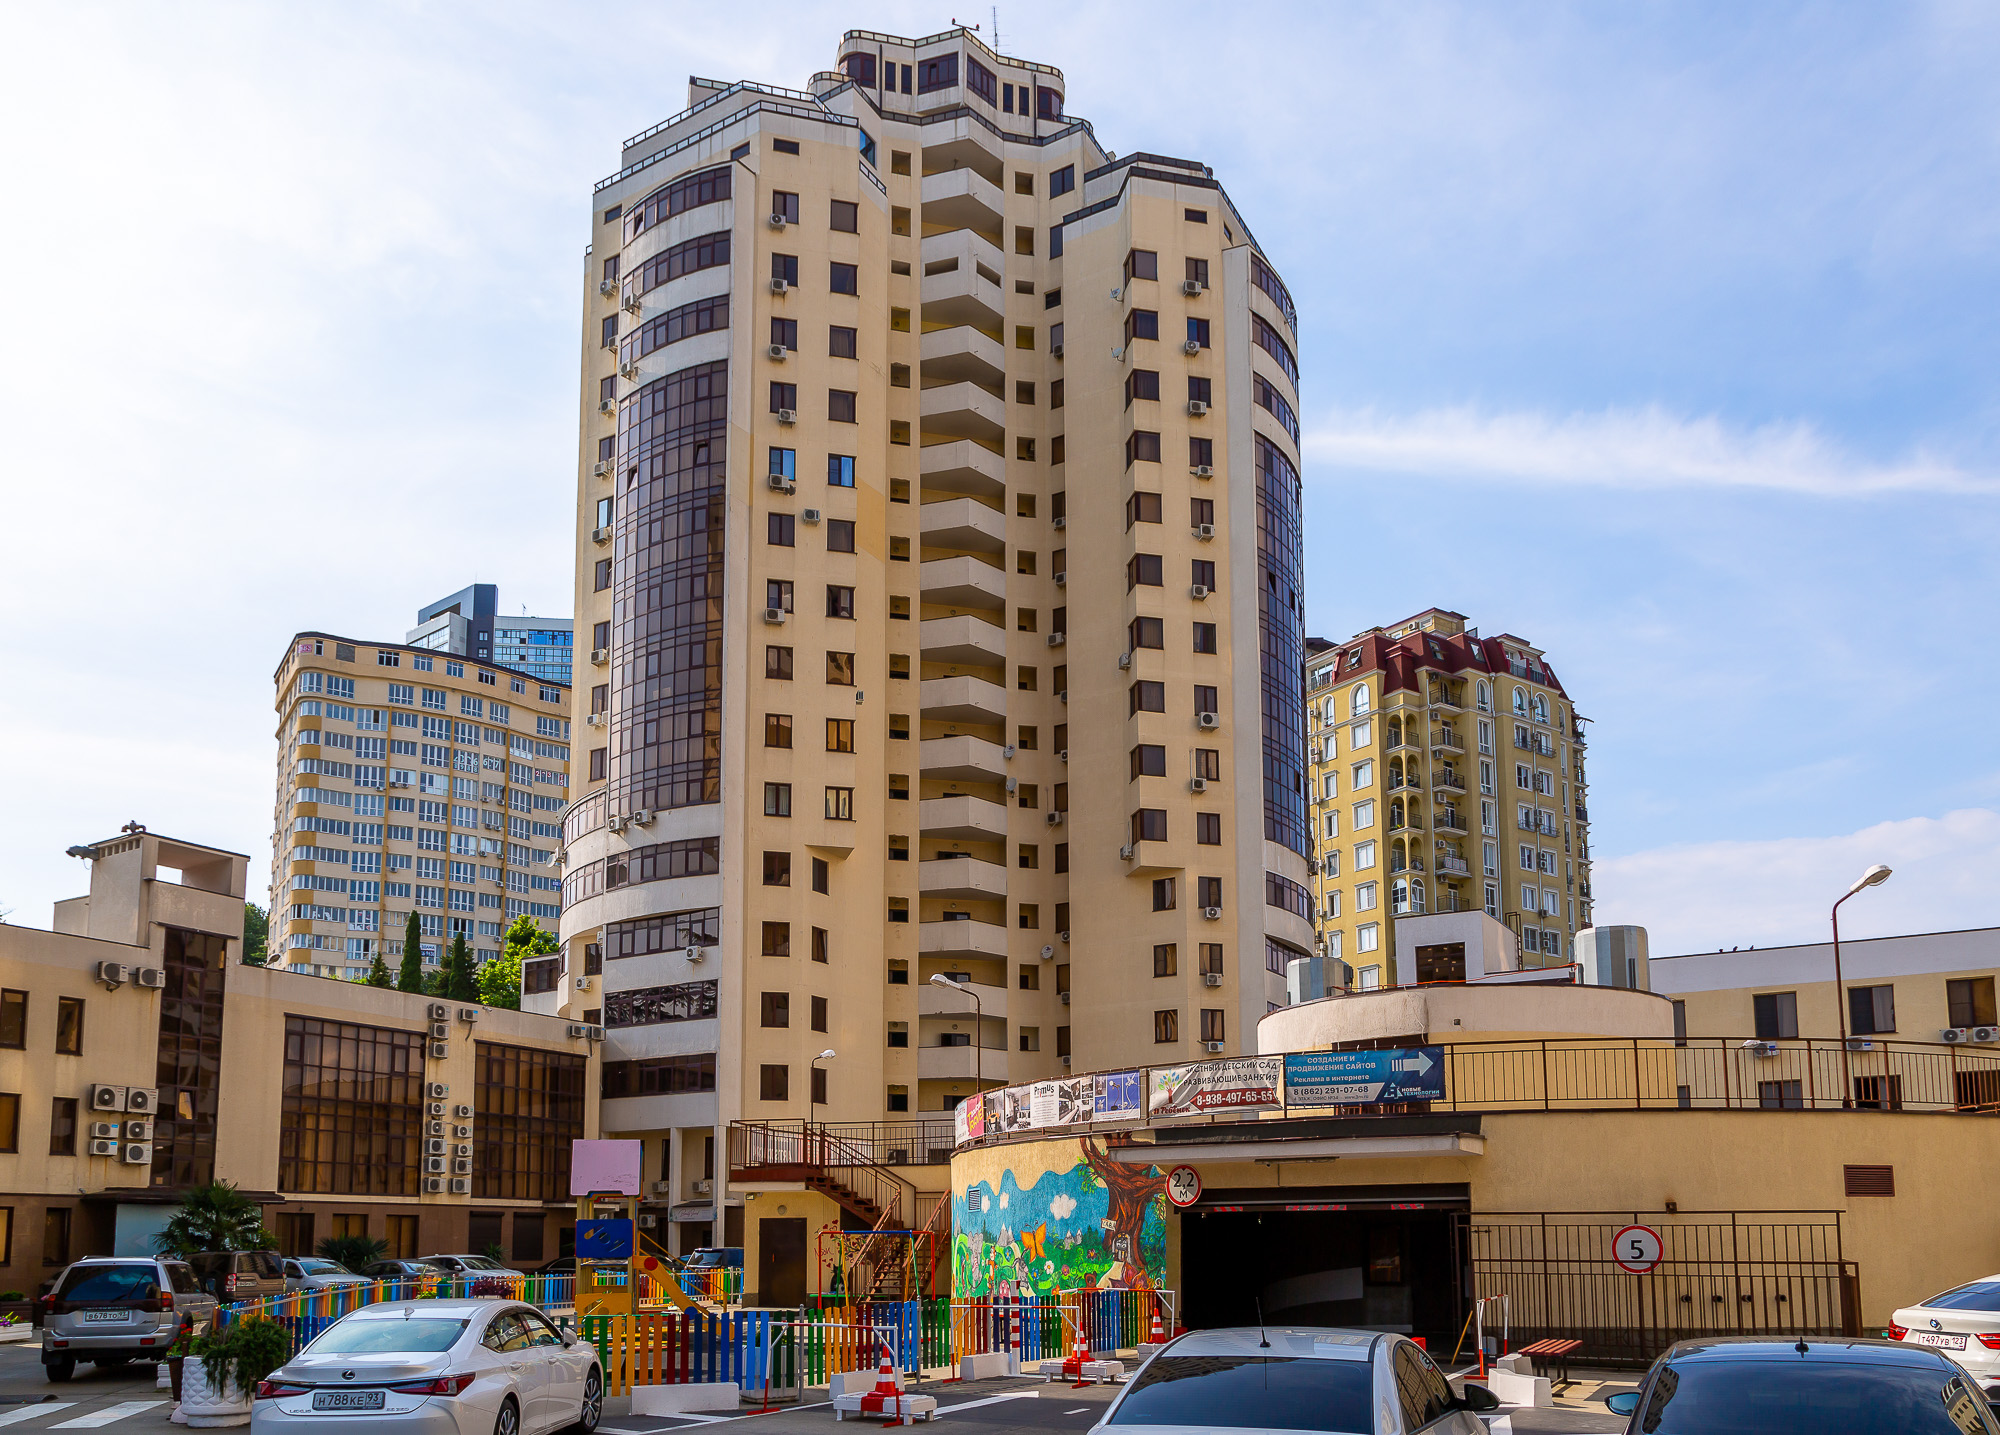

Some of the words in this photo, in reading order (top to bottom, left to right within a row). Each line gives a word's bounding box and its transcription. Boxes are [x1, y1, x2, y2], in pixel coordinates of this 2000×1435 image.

[1307, 1056, 1348, 1064] СОЗДАНИЕ
[1185, 1063, 1221, 1074] ЧАСТНЫЙ
[1221, 1060, 1257, 1071] ДЕТСКИЙ
[1258, 1061, 1278, 1070] САД
[1287, 1063, 1344, 1073] ПРОДВИЖЕНИЕ
[1345, 1062, 1377, 1070] САЙТОВ
[1331, 1074, 1370, 1082] интернете
[1300, 1088, 1323, 1096] (862)
[1325, 1086, 1369, 1094] 291-07-68
[1196, 1090, 1273, 1106] 8-938-497-65-65
[1173, 1173, 1194, 1190] 2,2
[1630, 1239, 1645, 1260] 5
[1922, 1336, 1950, 1346] Т497УВ
[1952, 1337, 1963, 1345] 123
[318, 1394, 365, 1406] Н788КЕ
[367, 1393, 378, 1401] 93
